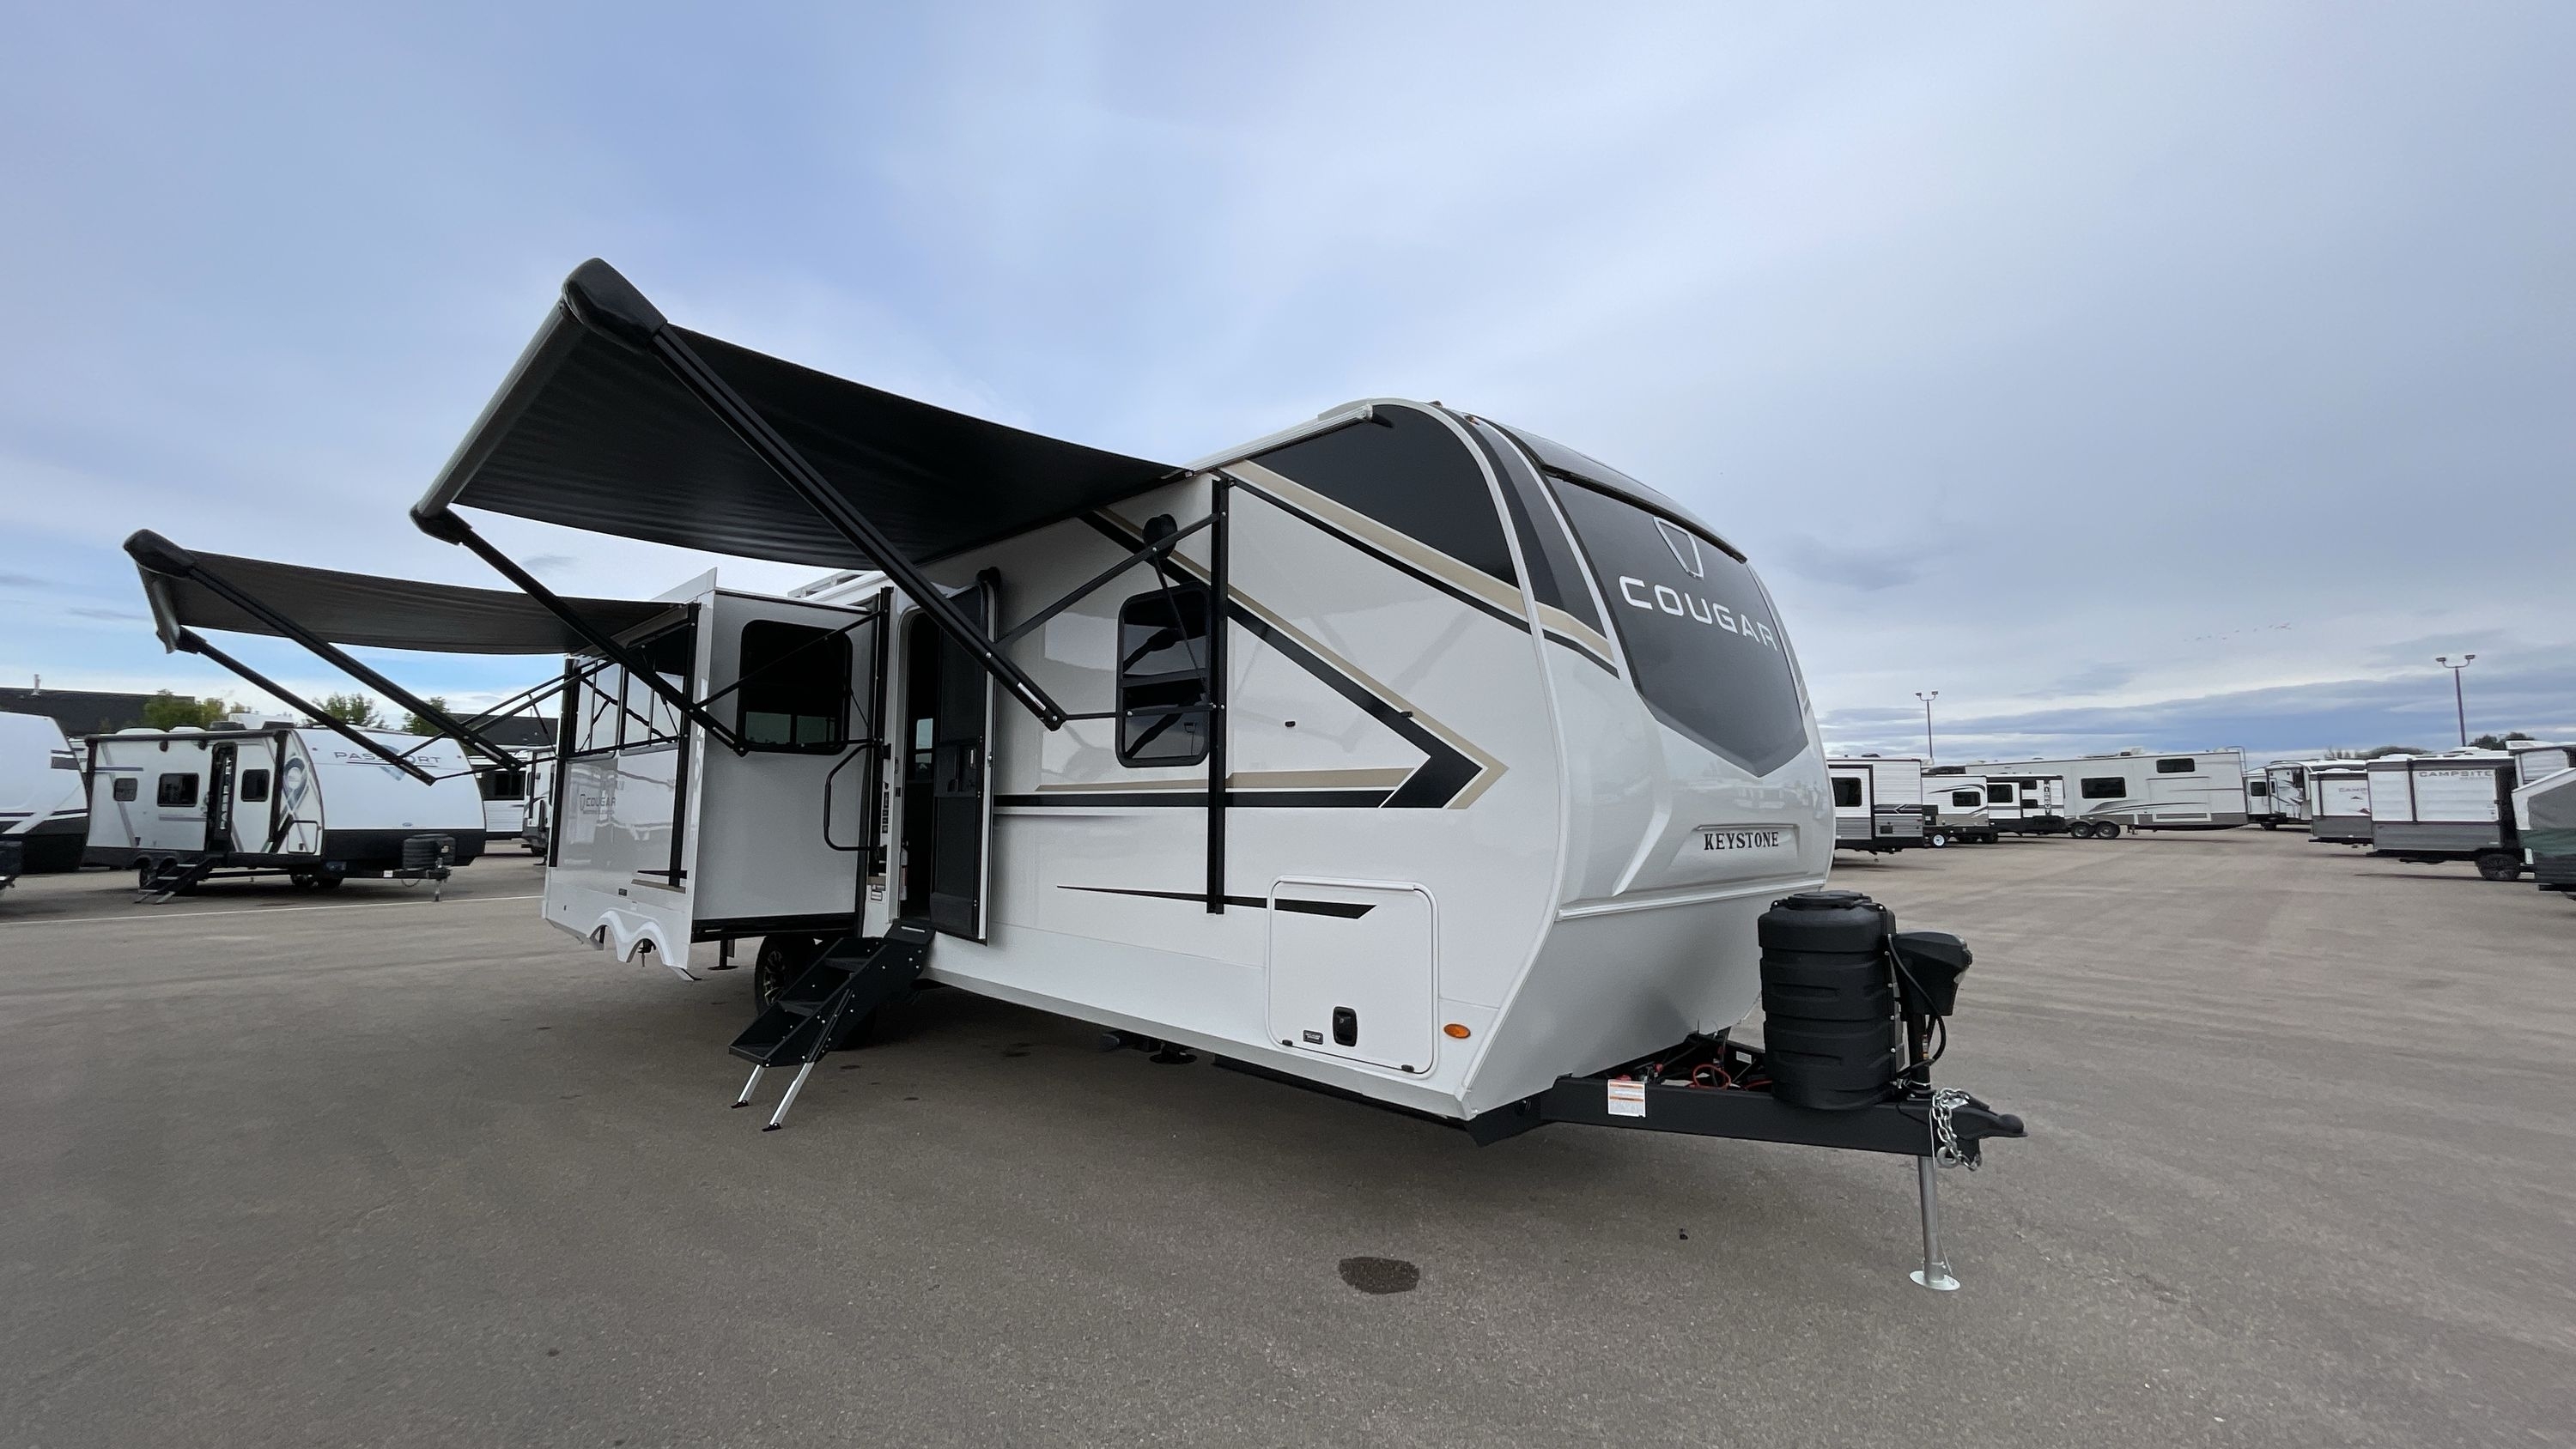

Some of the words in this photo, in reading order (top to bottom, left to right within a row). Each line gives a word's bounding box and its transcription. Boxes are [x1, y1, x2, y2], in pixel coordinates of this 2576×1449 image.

[1619, 575, 1778, 652] COUGAR
[333, 751, 441, 764] PASORT
[220, 756, 232, 830] PASSPRT
[586, 797, 617, 807] COUGAR
[1704, 831, 1779, 851] KEYSTONE
